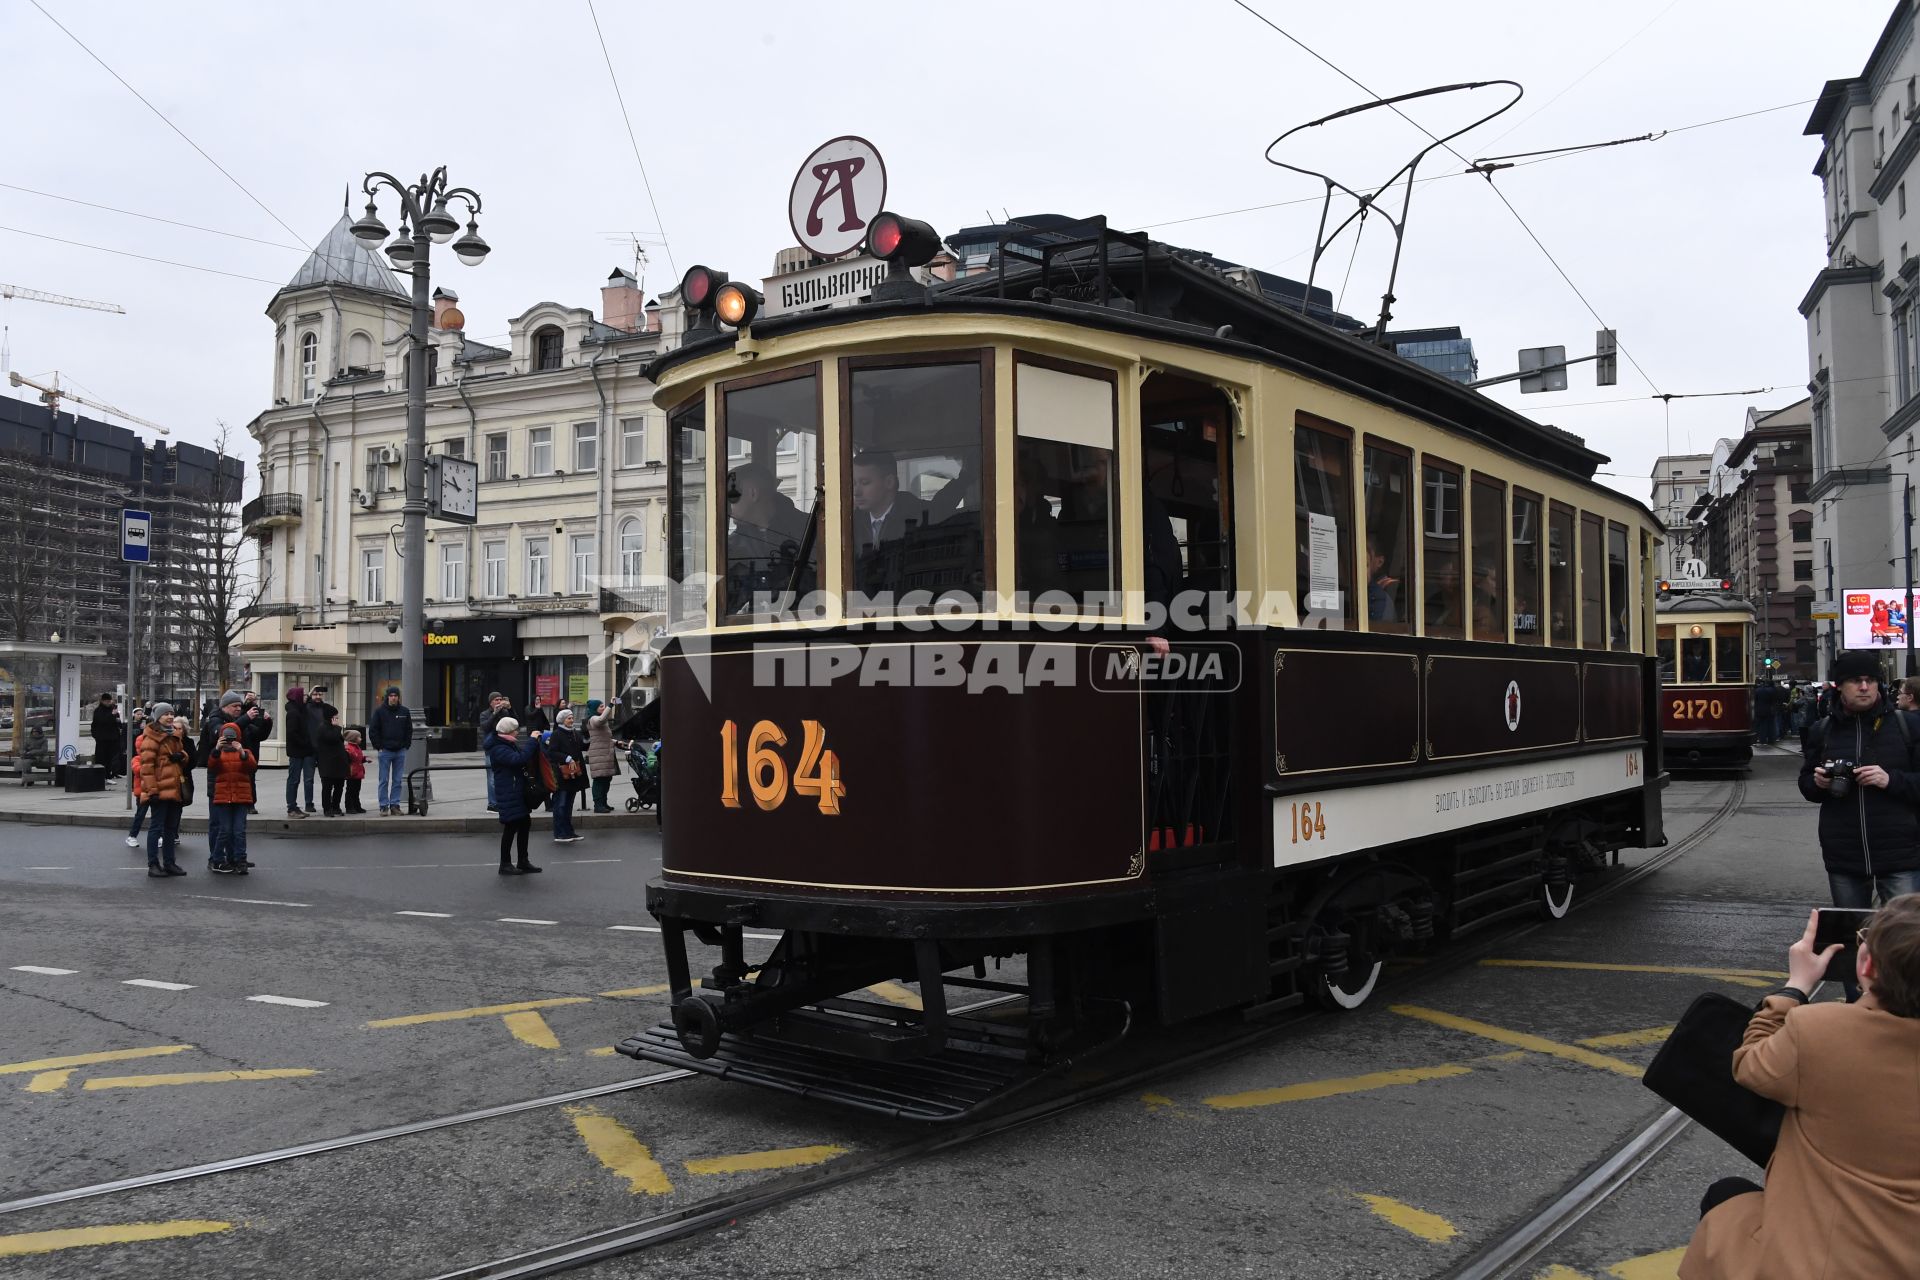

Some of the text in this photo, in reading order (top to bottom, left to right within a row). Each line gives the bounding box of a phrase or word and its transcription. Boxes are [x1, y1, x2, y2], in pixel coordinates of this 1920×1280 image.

[782, 264, 886, 308] БУЛЬВАРНА
[1686, 561, 1702, 578] 41
[1672, 699, 1723, 719] 2170
[720, 719, 846, 815] 164
[1625, 752, 1639, 777] 164
[1292, 801, 1326, 844] 164
